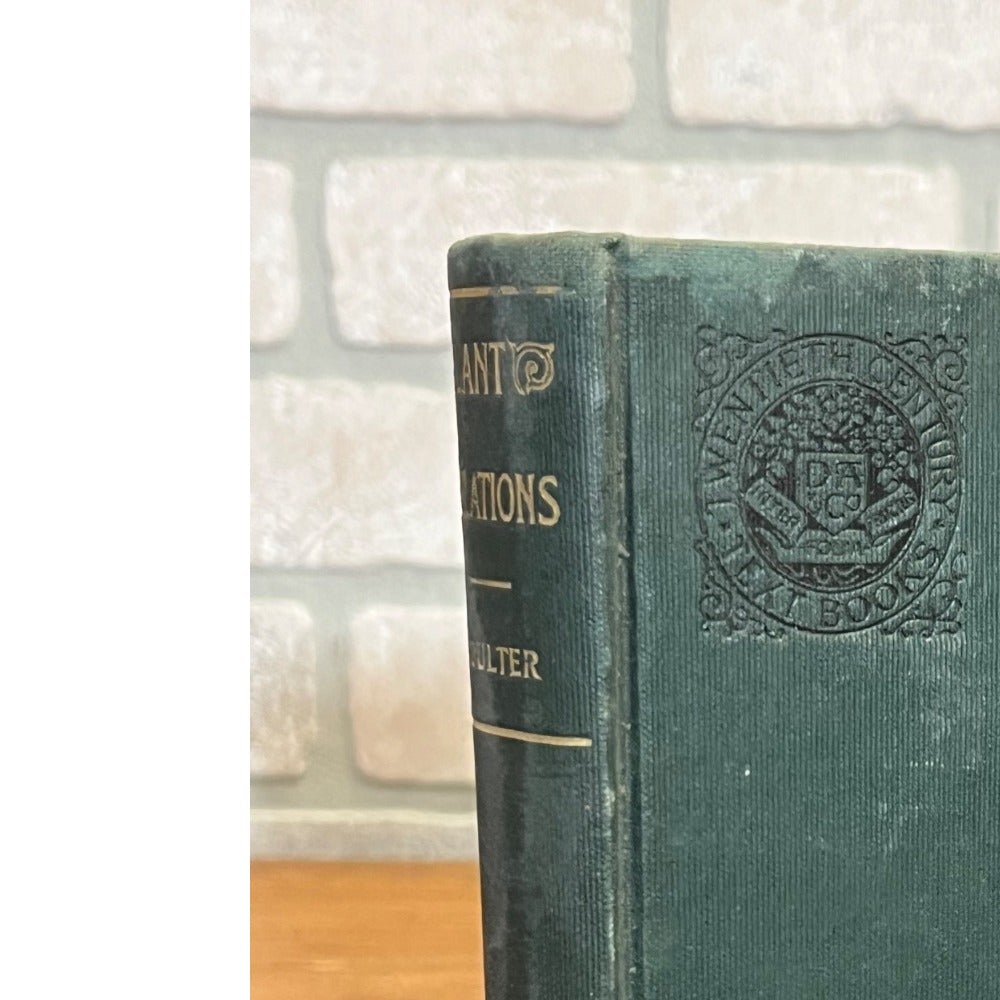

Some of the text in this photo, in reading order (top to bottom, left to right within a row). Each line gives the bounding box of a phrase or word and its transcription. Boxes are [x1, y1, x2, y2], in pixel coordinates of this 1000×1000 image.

[457, 341, 506, 395] ANT
[701, 340, 957, 516] TWENTIETH CENTURY
[721, 533, 941, 627] TEXT BOOKS
[470, 640, 543, 681] ULTER
